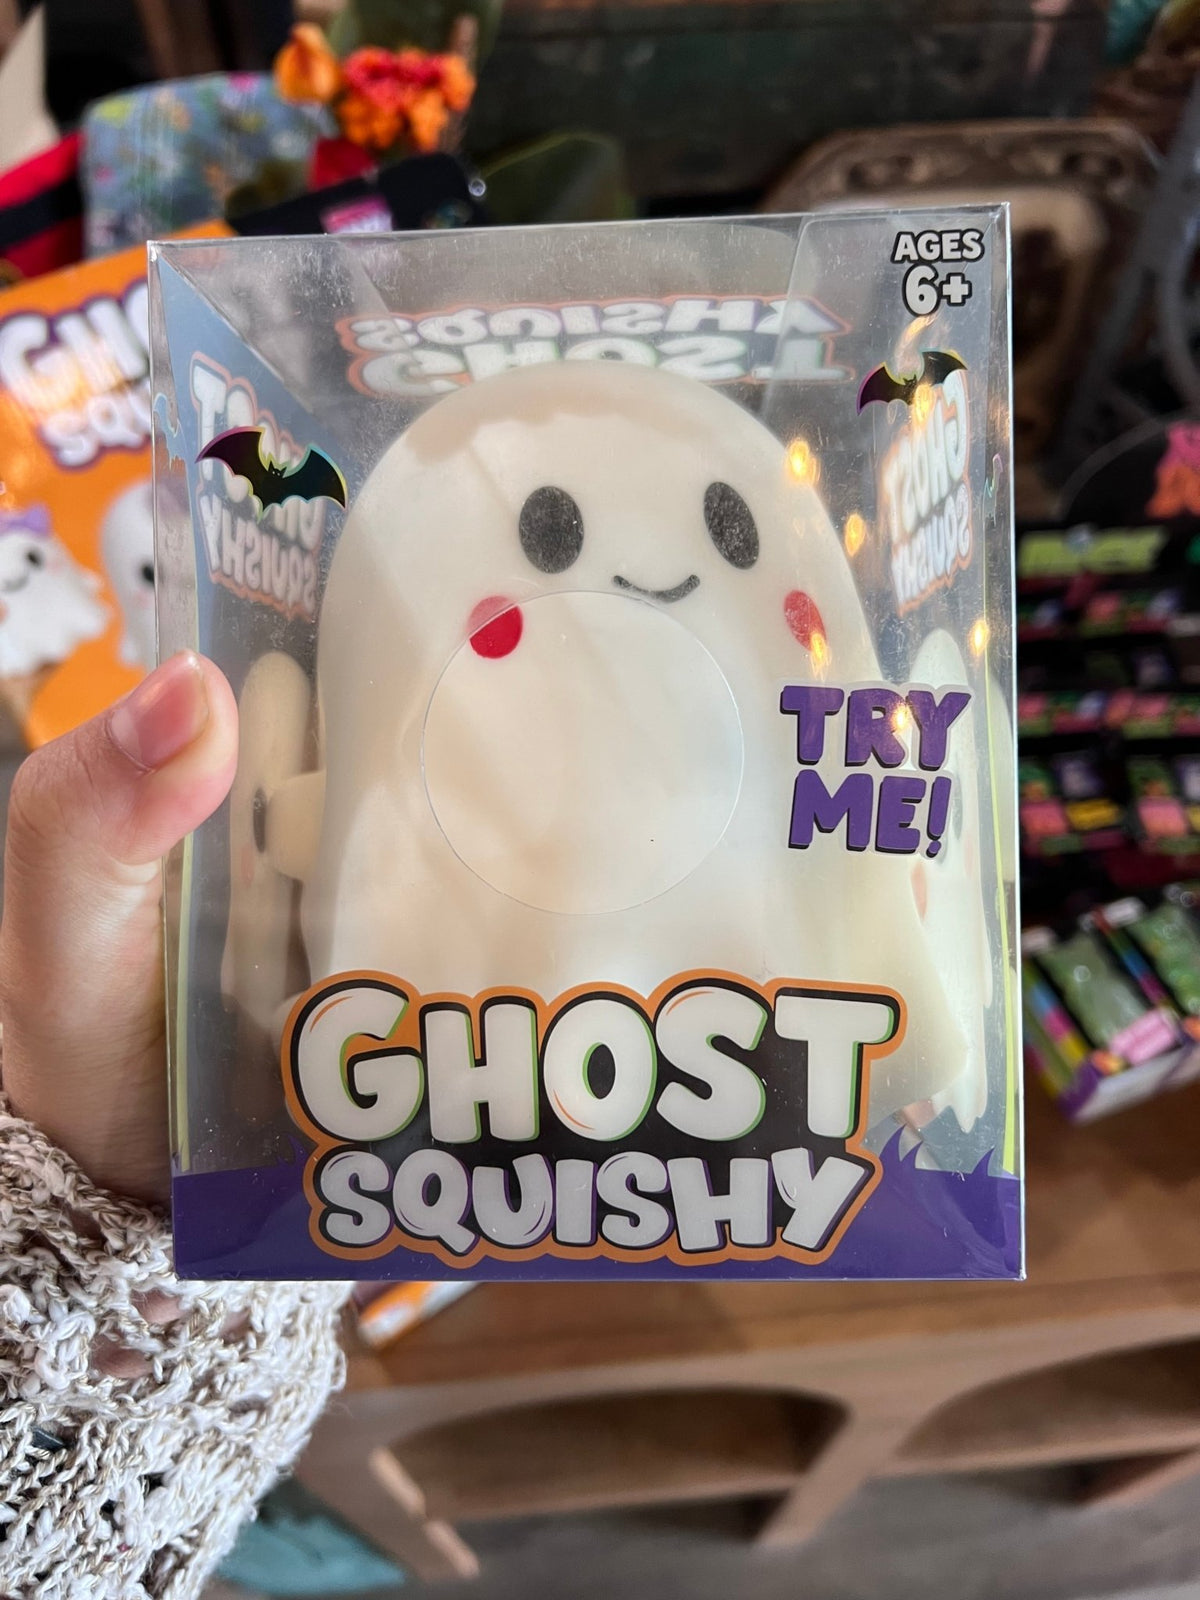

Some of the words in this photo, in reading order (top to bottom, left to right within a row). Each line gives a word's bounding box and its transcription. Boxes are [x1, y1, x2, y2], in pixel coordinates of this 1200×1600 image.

[892, 229, 983, 262] AGES
[903, 265, 972, 316] 6+
[780, 686, 971, 771] TRY
[788, 769, 952, 858] ME!
[294, 981, 899, 1144] GHOST
[318, 1147, 872, 1254] SQUISHY
